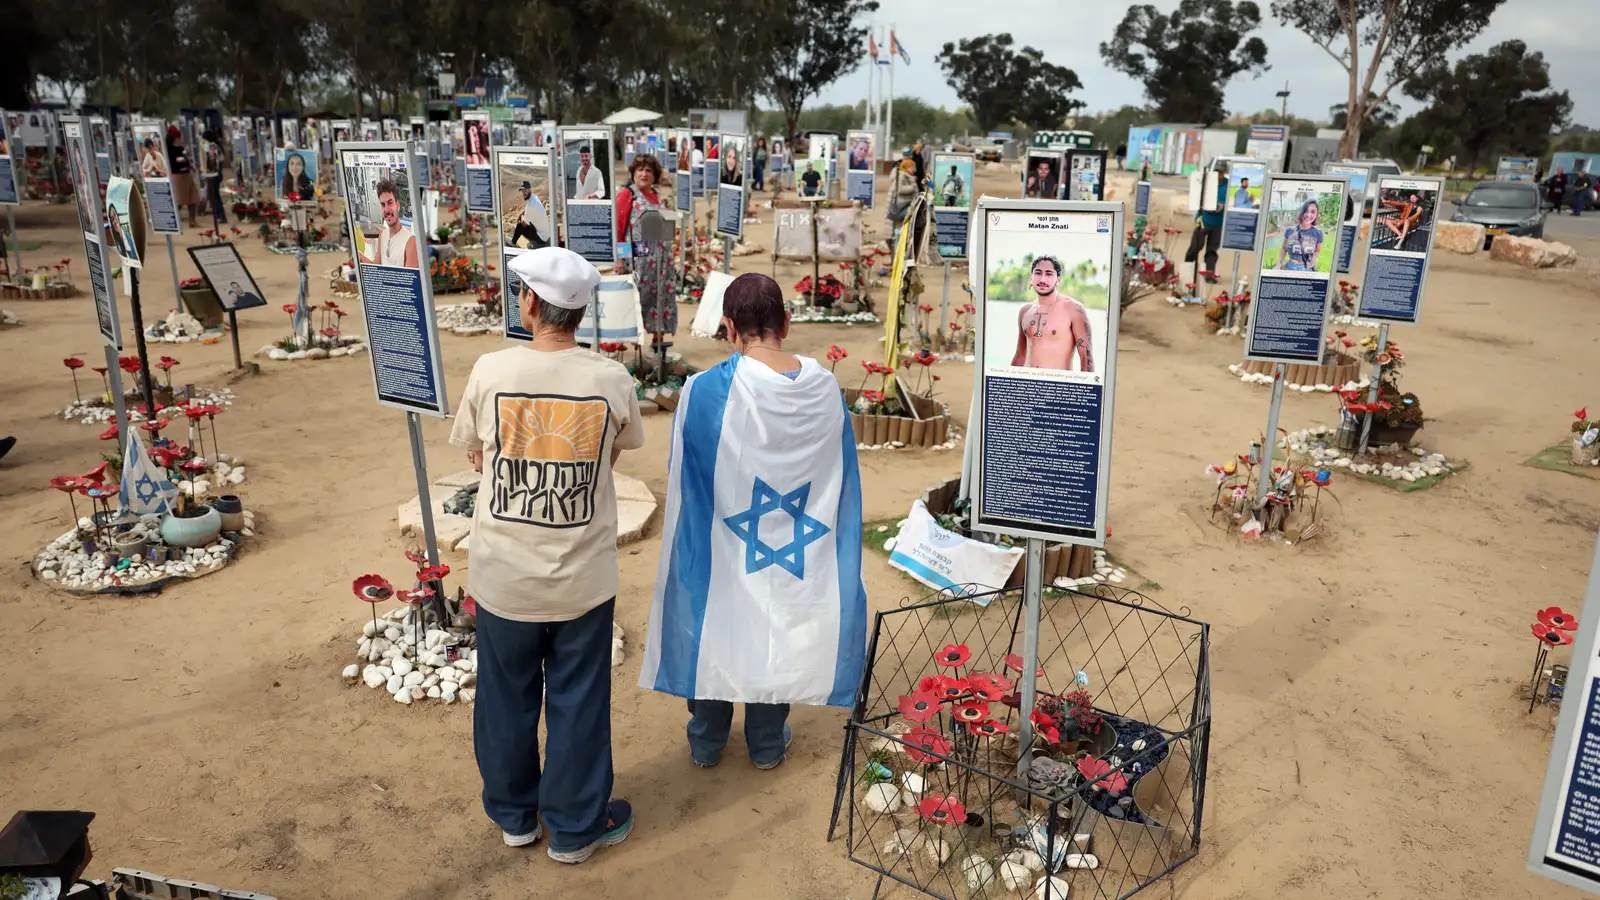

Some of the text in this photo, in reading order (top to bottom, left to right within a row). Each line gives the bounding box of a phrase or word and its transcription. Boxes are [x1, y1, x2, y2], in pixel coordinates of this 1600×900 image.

[1573, 791, 1587, 800] On
[1583, 802, 1599, 811] the
[1569, 812, 1584, 821] We
[1568, 819, 1583, 828] the
[1565, 832, 1588, 846] Roni,
[1562, 846, 1595, 862] forever
